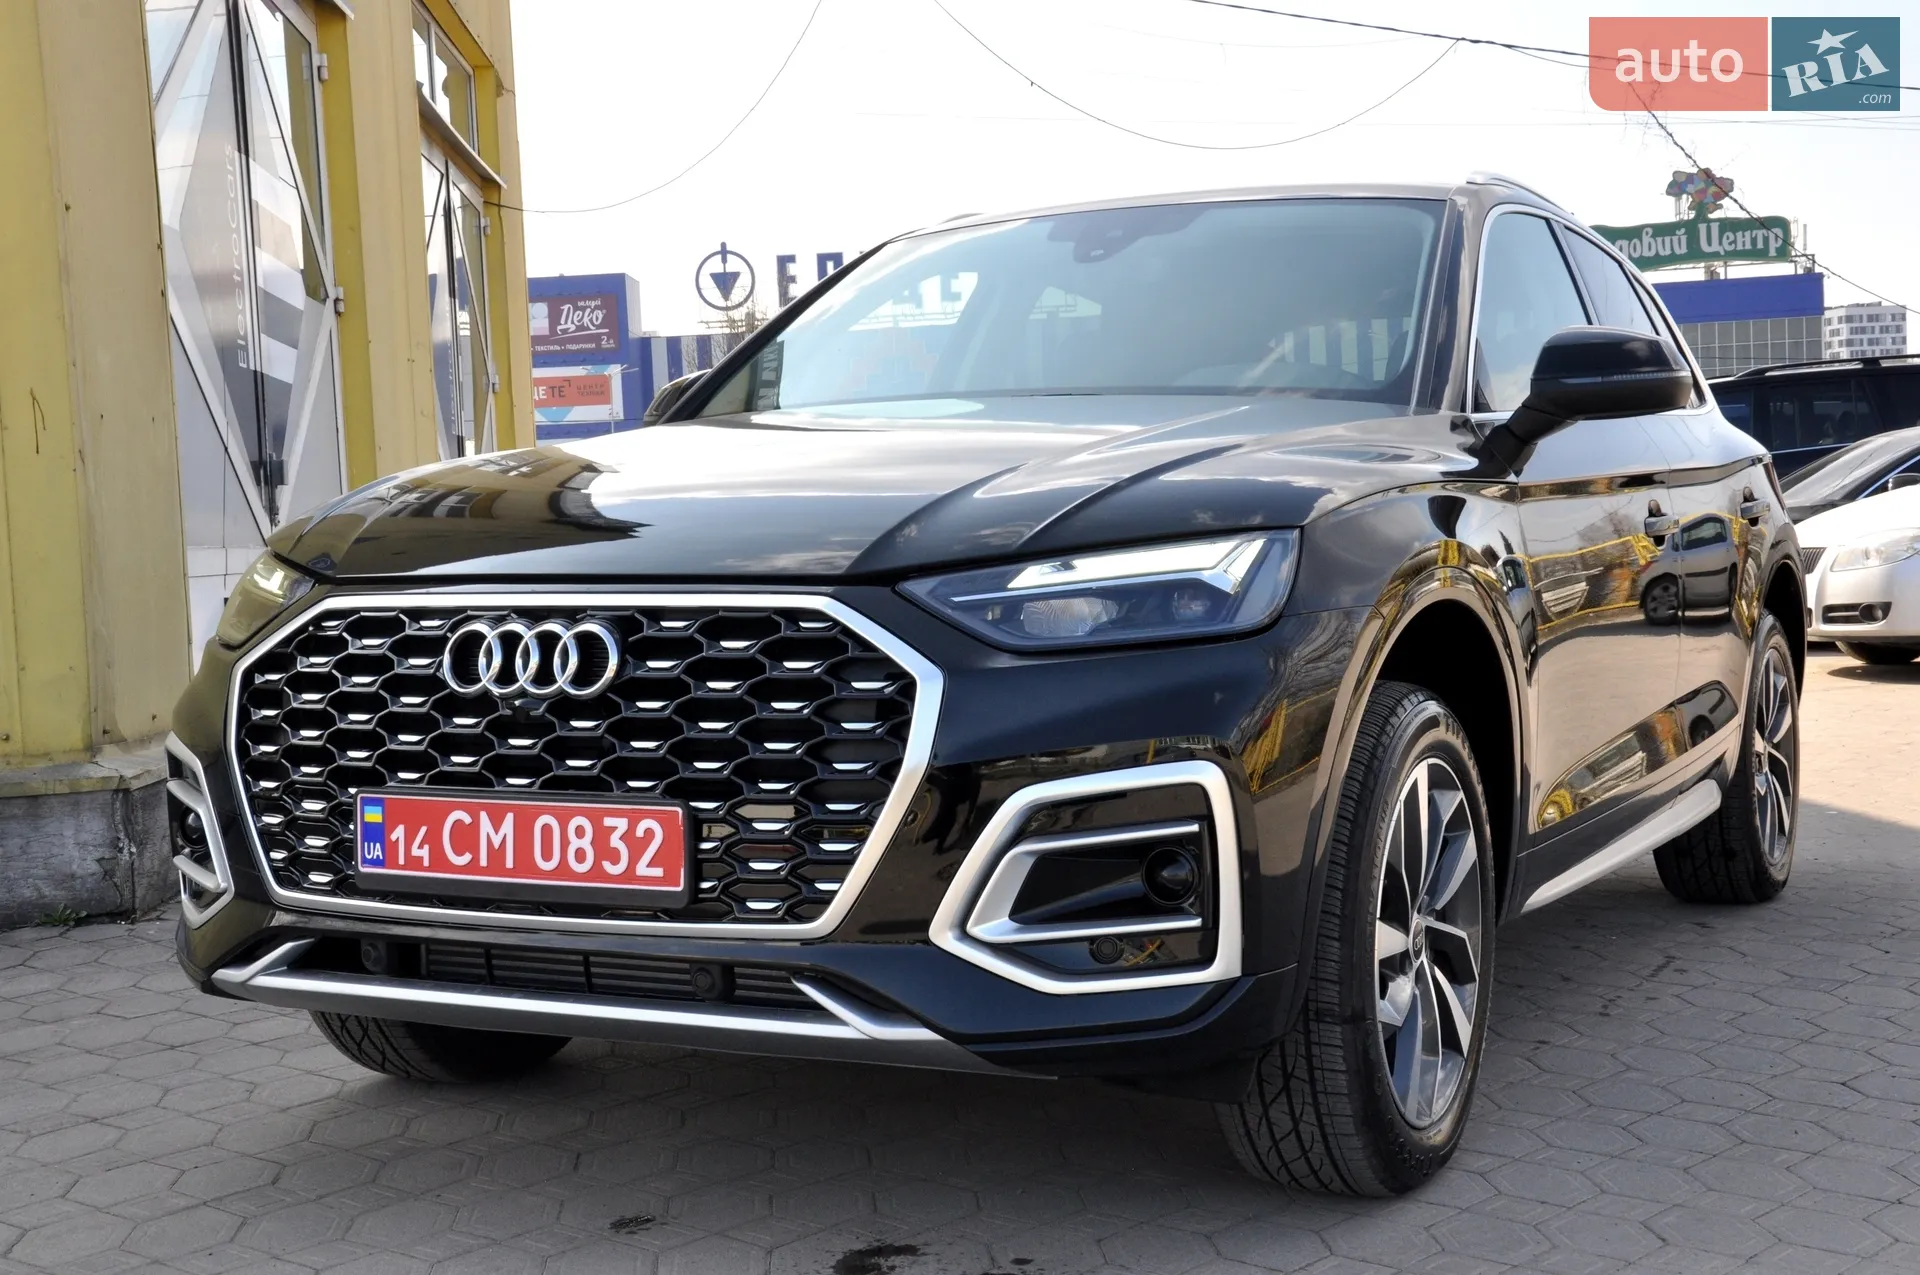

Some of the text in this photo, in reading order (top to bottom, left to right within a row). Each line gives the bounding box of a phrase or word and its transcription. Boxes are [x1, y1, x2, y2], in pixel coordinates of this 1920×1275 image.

[1698, 221, 1784, 257] Центр
[225, 144, 247, 369] ElectroCars
[557, 304, 604, 334] Деко
[549, 385, 566, 398] ТЕ
[364, 841, 383, 860] UA
[389, 809, 665, 878] 14 CM 0832
